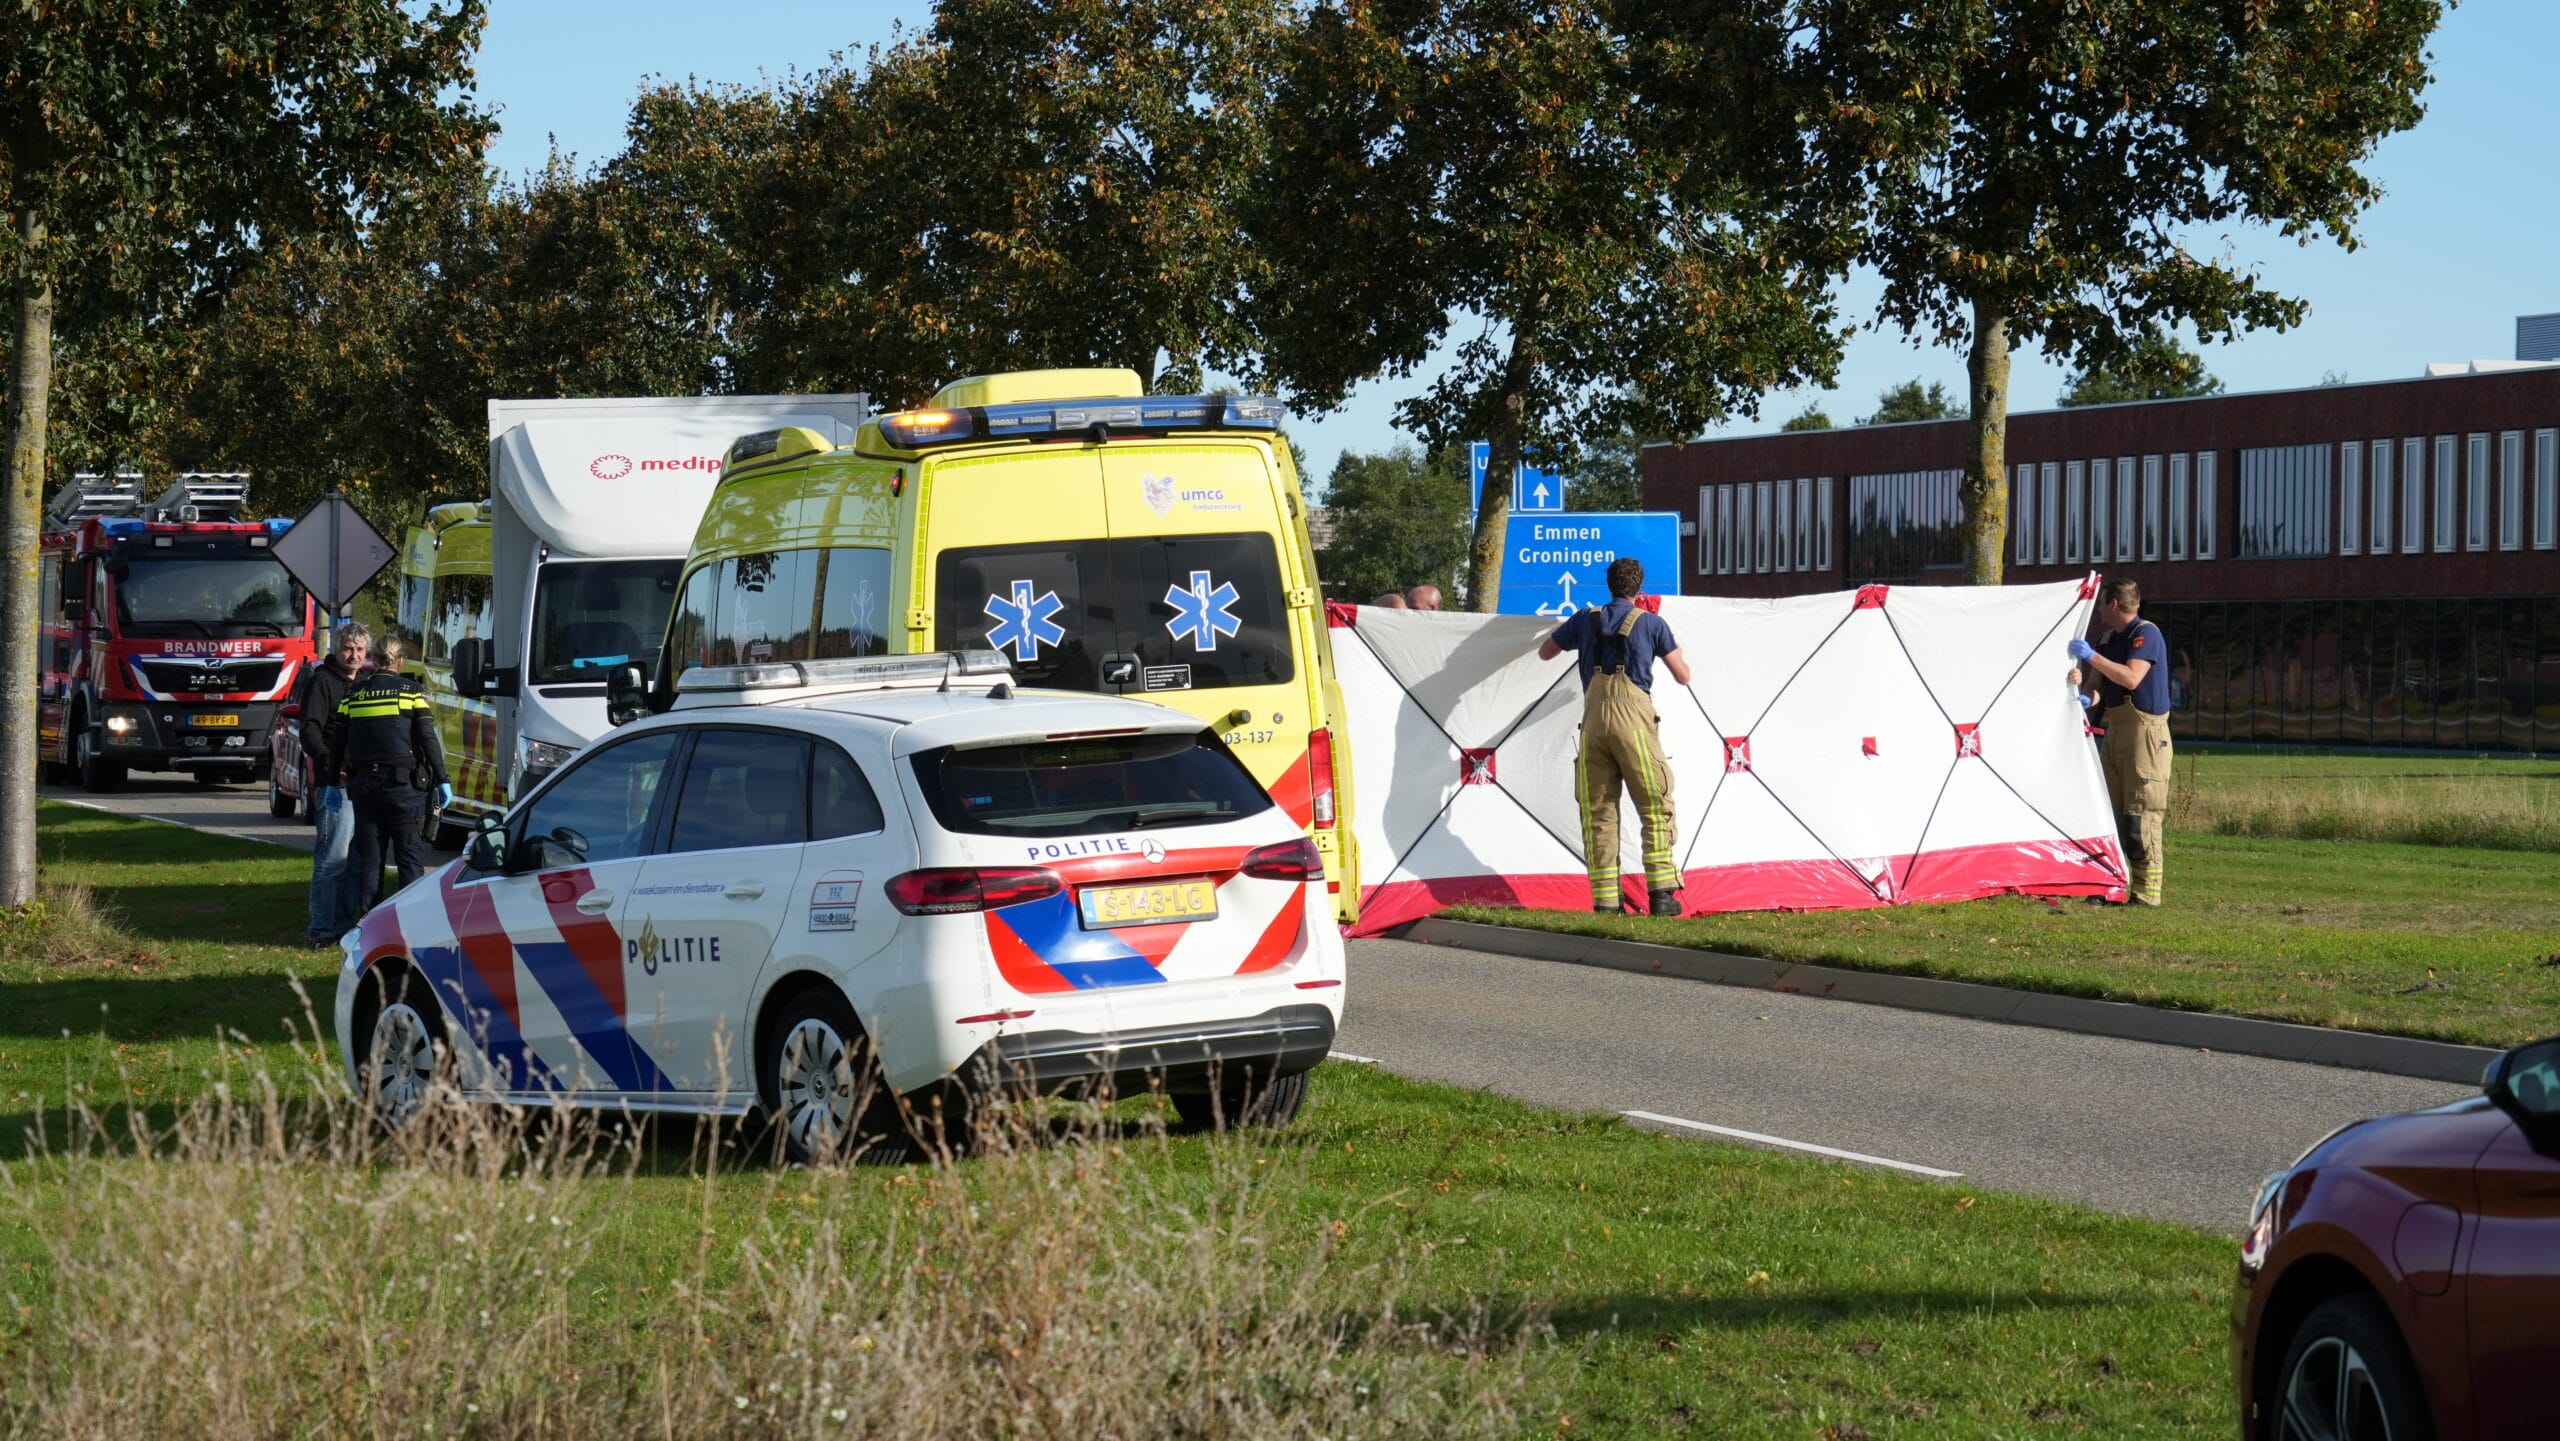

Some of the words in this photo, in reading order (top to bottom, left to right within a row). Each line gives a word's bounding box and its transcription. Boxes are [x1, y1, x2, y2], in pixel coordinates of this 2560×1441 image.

[641, 456, 722, 473] medip
[1534, 524, 1601, 540] Emmen
[1519, 547, 1615, 567] Groningen
[164, 641, 262, 653] BRANDWEER
[190, 675, 237, 685] MAN
[1224, 731, 1274, 745] 03-137
[1027, 838, 1130, 860] POLITIE
[1104, 886, 1203, 917] S-143-LG
[627, 936, 720, 976] POLITIE
